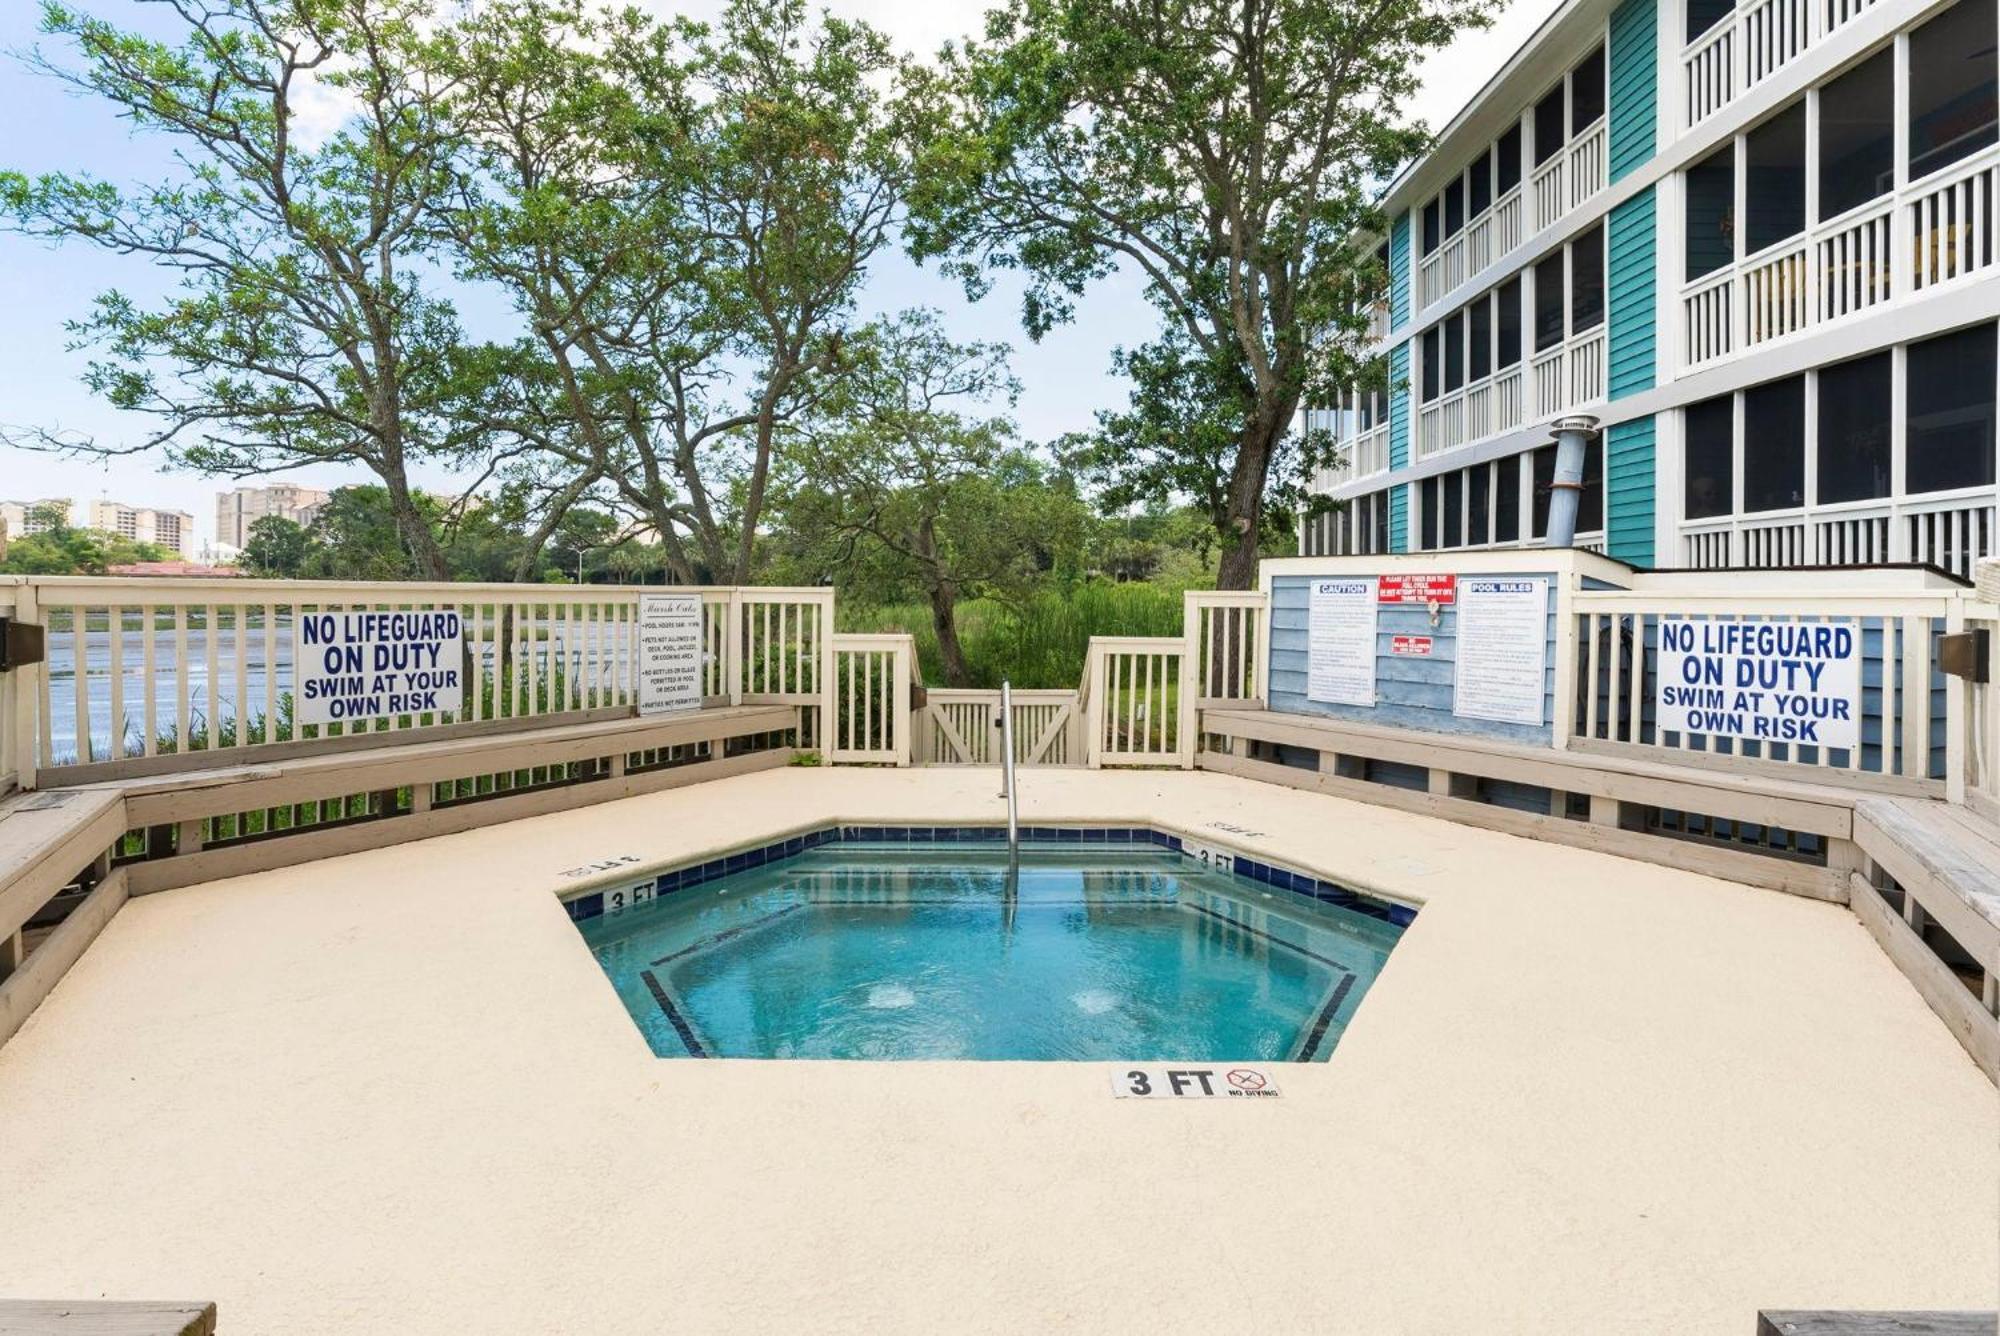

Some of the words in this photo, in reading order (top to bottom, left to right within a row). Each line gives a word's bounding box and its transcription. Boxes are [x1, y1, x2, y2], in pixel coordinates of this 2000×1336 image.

[1322, 584, 1364, 593] CAUTION
[1472, 583, 1498, 592] POOL
[1500, 583, 1531, 592] RULES
[303, 615, 336, 645] NO
[344, 613, 459, 643] LIFEGUARD
[1663, 624, 1695, 652] NO
[1704, 625, 1852, 659] LIFEGUARD
[324, 645, 363, 674] ON
[374, 642, 442, 671] DUTY
[304, 676, 364, 699] SWIM
[372, 674, 397, 694] AT
[405, 670, 458, 691] YOUR
[1682, 655, 1723, 686] ON
[1736, 658, 1826, 692] DUTY
[330, 696, 380, 718] OWN
[389, 691, 438, 713] RISK
[1663, 686, 1724, 709] SWIM
[1733, 692, 1764, 713] AT
[1774, 693, 1850, 721] YOUR
[1687, 710, 1743, 734] OWN
[1754, 716, 1818, 742] RISK
[1215, 853, 1233, 871] FT
[612, 892, 624, 909] 3
[633, 882, 655, 904] FT
[1127, 1070, 1152, 1096] 3
[1167, 1070, 1214, 1096] FT
